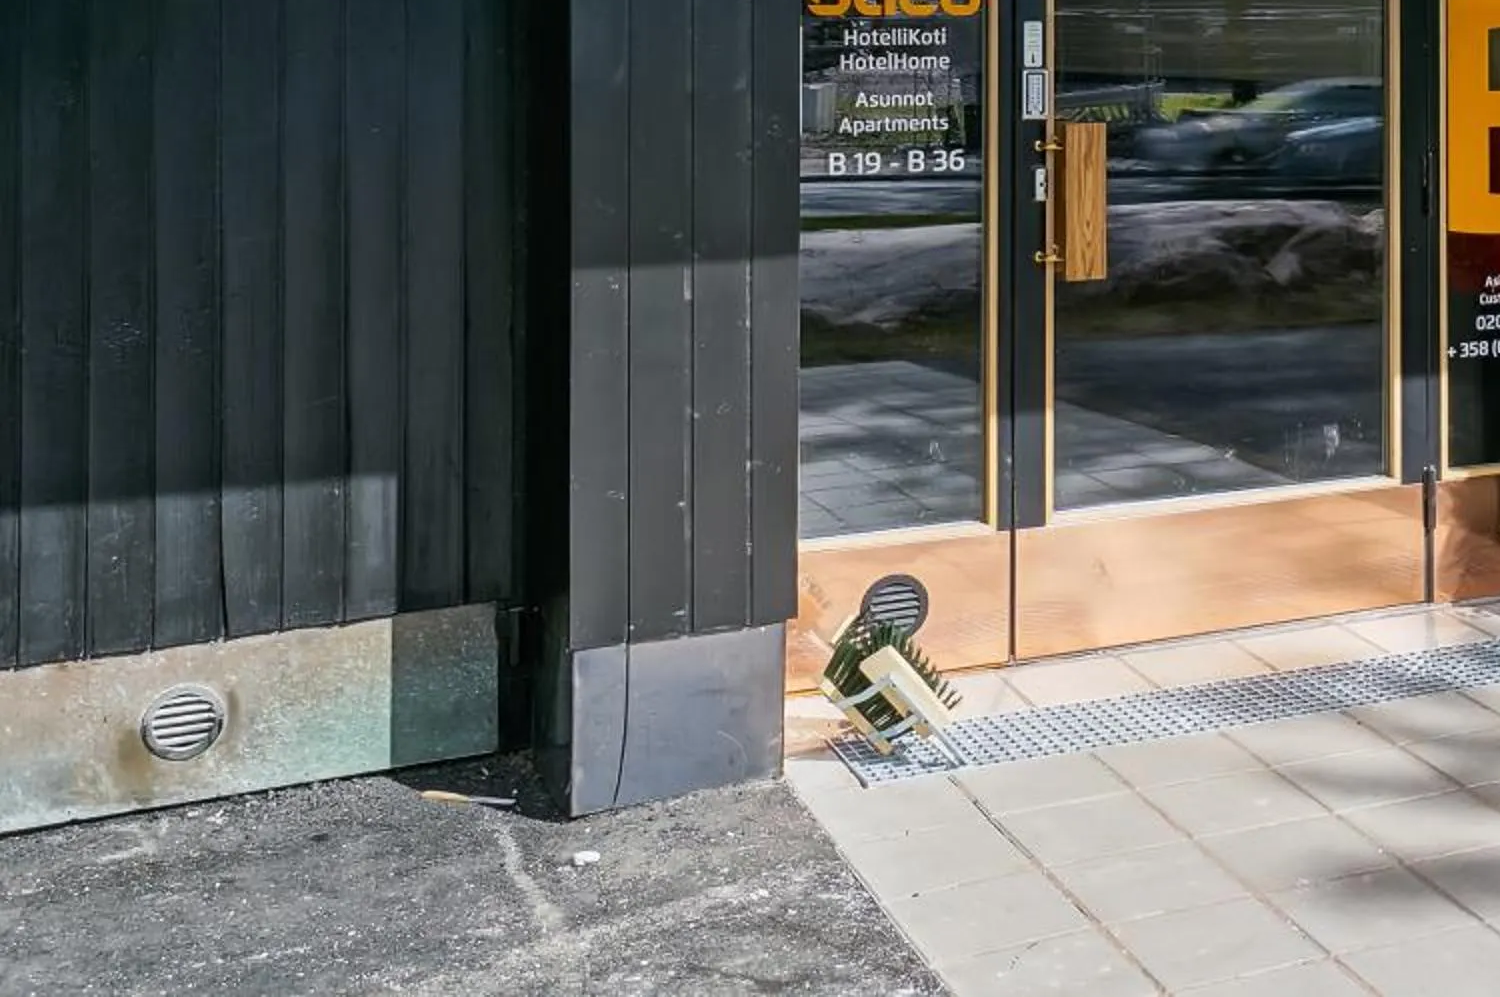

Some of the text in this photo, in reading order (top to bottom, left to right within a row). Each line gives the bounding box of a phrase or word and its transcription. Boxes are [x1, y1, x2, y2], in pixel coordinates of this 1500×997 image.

[843, 27, 947, 47] HotelliKoti
[840, 53, 951, 72] HotelHome
[855, 91, 934, 108] Asunnot
[839, 114, 949, 134] Apartments
[829, 152, 846, 175] B
[852, 152, 881, 175] 19
[907, 150, 925, 173] B
[932, 149, 965, 172] 36
